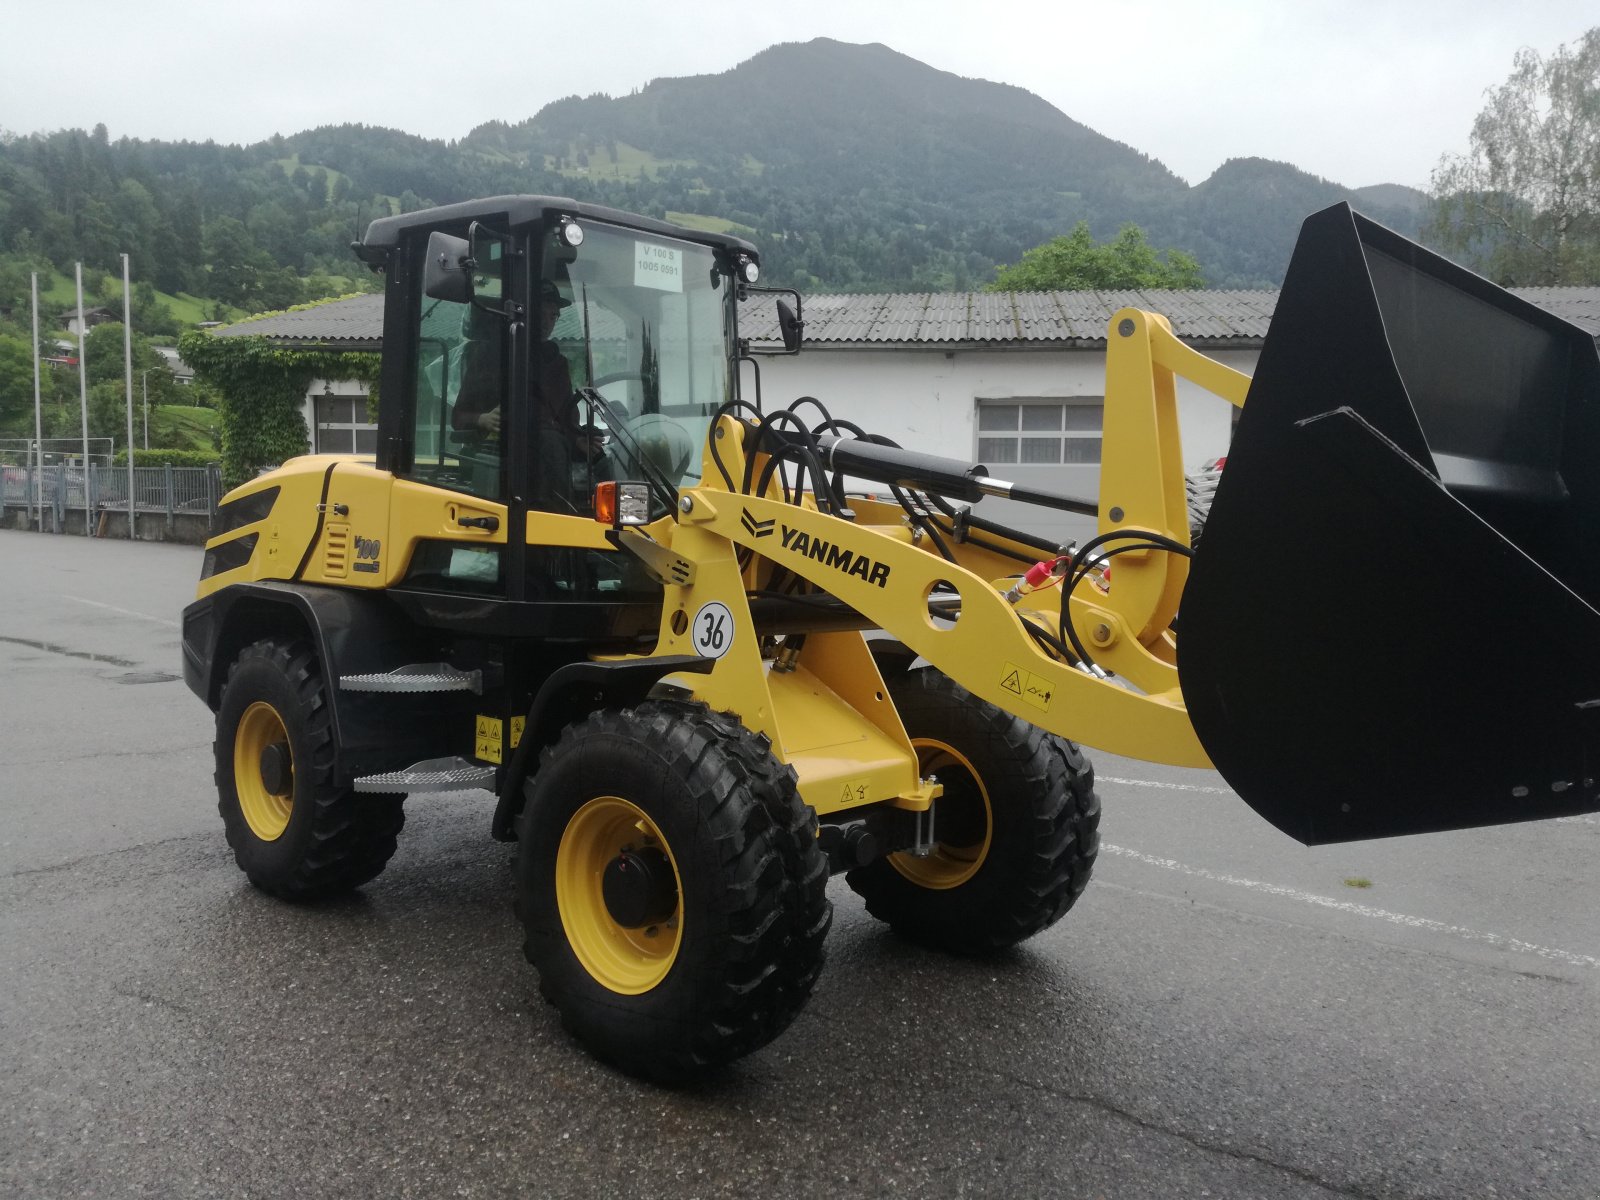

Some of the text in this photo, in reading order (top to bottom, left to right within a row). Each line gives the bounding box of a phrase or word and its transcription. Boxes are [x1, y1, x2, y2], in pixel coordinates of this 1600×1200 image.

[643, 246, 650, 255] V
[653, 248, 667, 259] 100
[638, 260, 659, 271] 1005
[780, 524, 891, 589] YANMAR
[699, 612, 726, 650] 36
